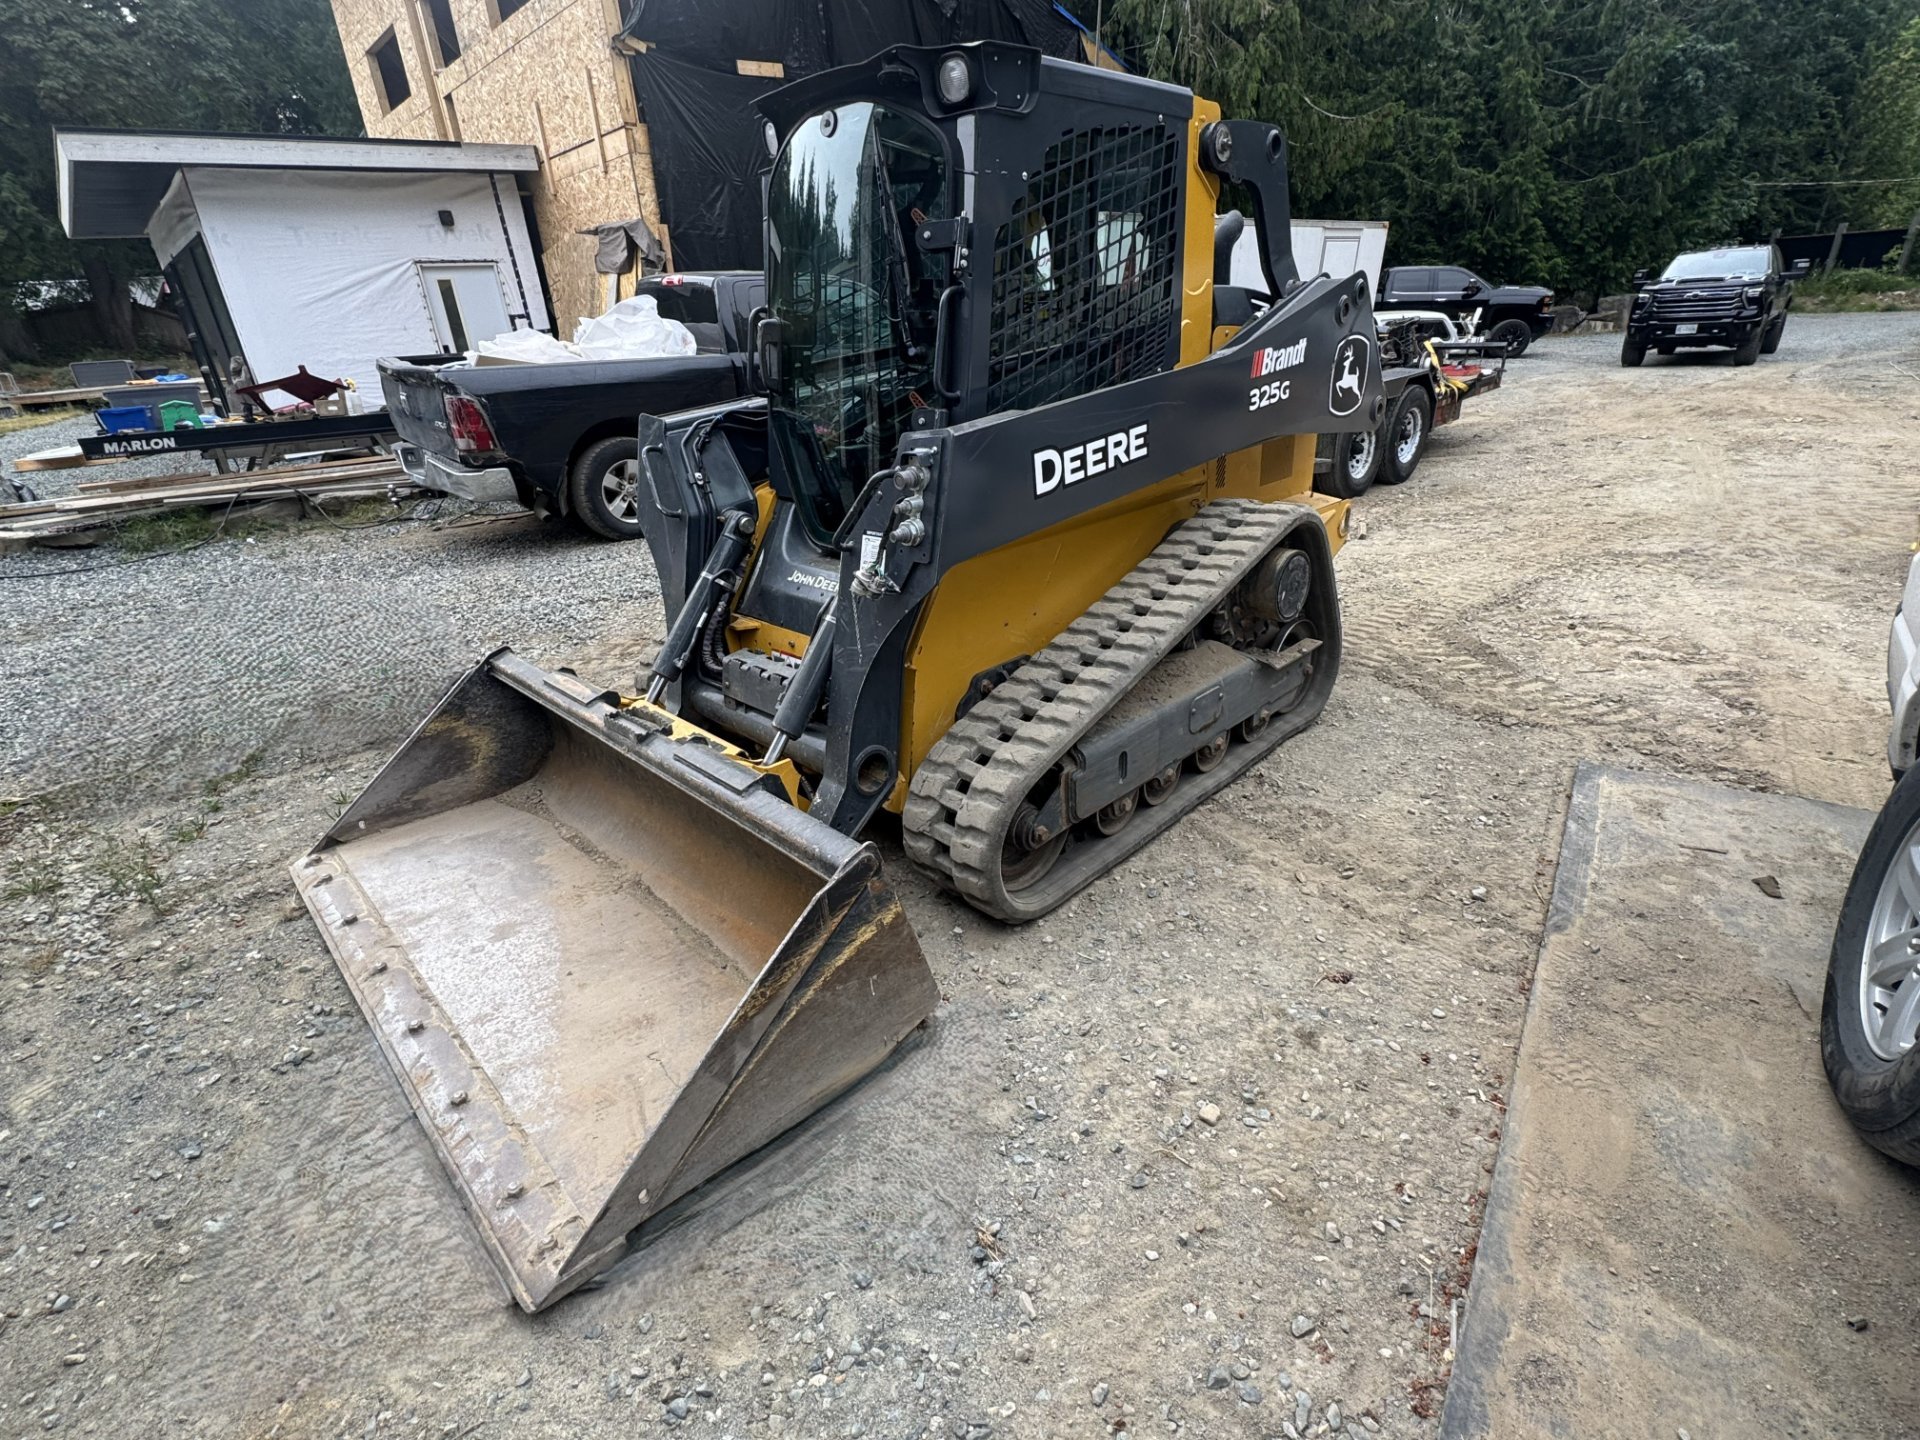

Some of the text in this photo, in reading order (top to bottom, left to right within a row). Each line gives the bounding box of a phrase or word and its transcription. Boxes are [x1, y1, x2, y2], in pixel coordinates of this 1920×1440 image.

[418, 223, 495, 243] Tyvek
[1260, 337, 1308, 376] Brandt
[1248, 380, 1291, 411] 325G
[103, 437, 176, 454] MARLON
[1033, 423, 1148, 496] DEERE
[787, 570, 816, 587] JOHN
